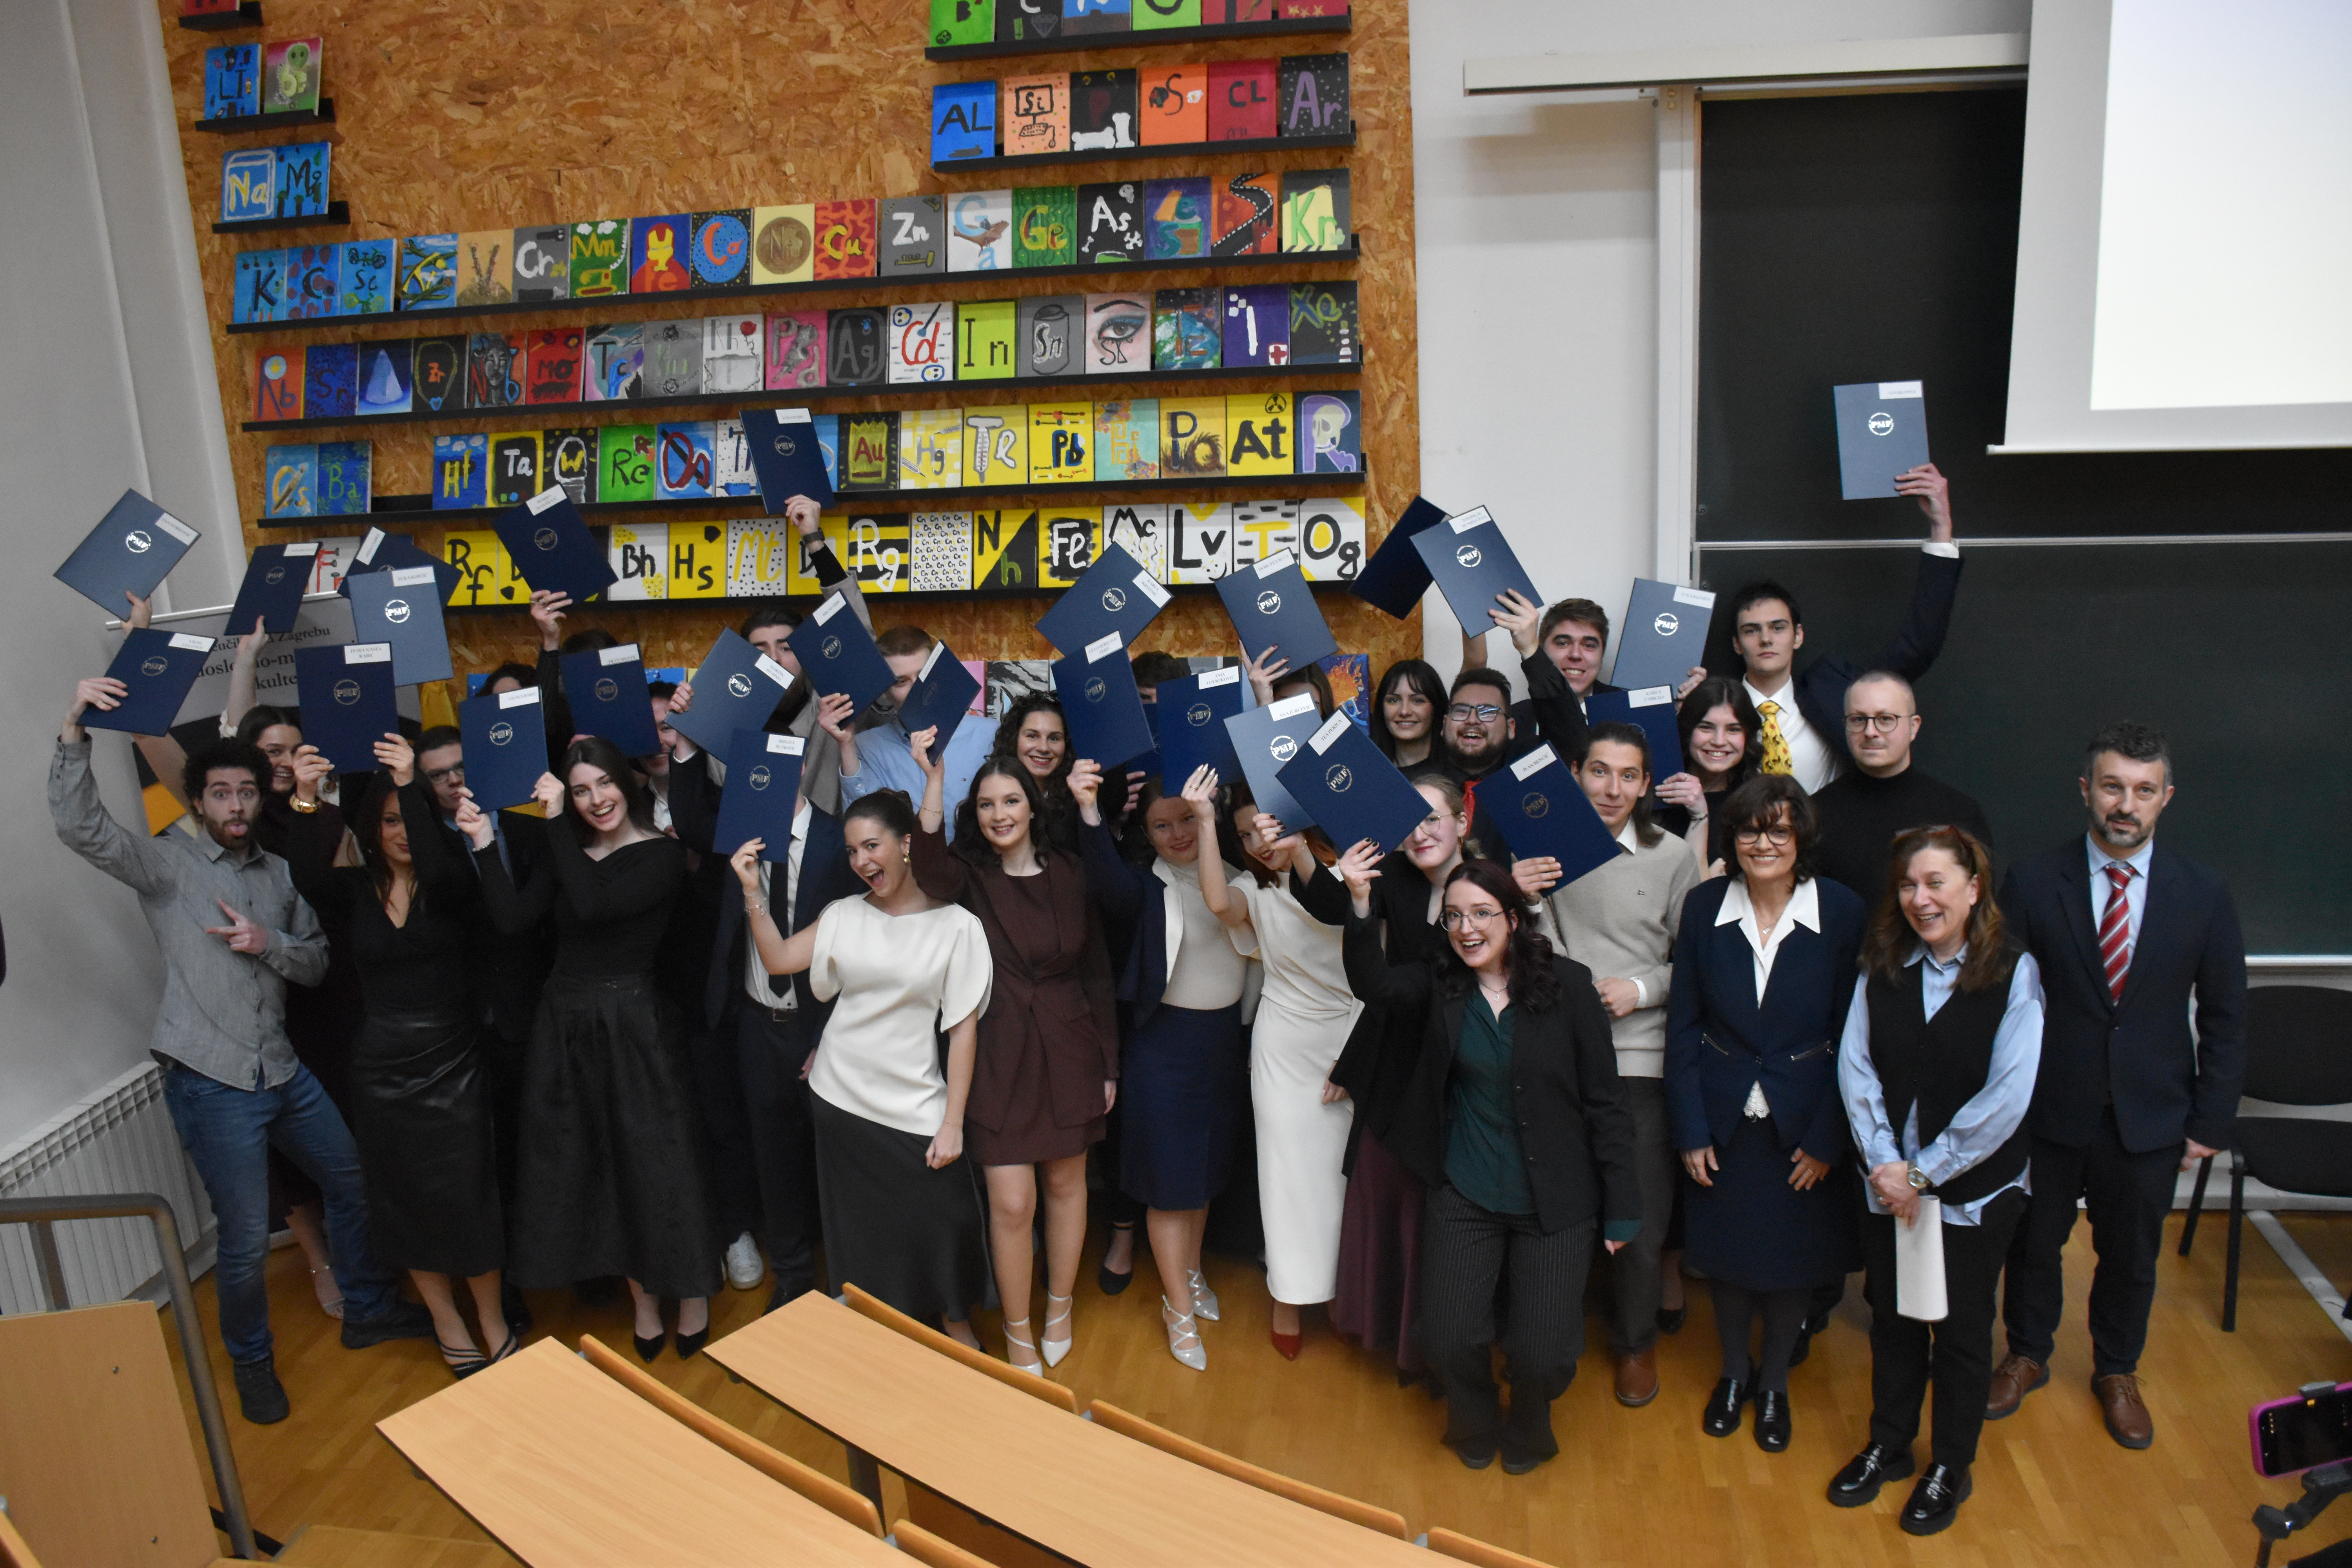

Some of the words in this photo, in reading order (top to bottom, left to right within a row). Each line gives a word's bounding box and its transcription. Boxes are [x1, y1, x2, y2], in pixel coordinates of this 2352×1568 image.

[1024, 92, 1044, 113] Si
[1165, 73, 1183, 116] S
[1289, 71, 1341, 129] Ar
[937, 102, 993, 135] AL
[229, 171, 267, 212] Na
[892, 212, 929, 245] Zn
[1022, 205, 1066, 251] Ge
[1091, 196, 1131, 232] As
[1290, 191, 1337, 247] Kr
[516, 241, 554, 278] Cr
[571, 233, 619, 259] Mn
[703, 223, 743, 265] Co
[824, 224, 863, 260] Cu
[254, 269, 278, 311] K
[711, 319, 738, 350] Rh
[902, 321, 940, 365] Cd
[964, 318, 1008, 367] In
[1033, 323, 1063, 363] Sn
[855, 436, 885, 464] Au
[916, 435, 945, 476] Hg
[1052, 430, 1085, 469] Pb
[1230, 417, 1287, 465] At
[504, 449, 533, 477] Ta
[561, 450, 584, 472] W
[612, 449, 650, 487] Re
[328, 464, 361, 499] Ba
[1109, 508, 1156, 542] Mc
[1173, 509, 1227, 568] Lv
[622, 544, 656, 579] Bh
[733, 529, 782, 583] Mt
[852, 519, 900, 592] Rg
[978, 510, 1022, 586] Nh
[1303, 514, 1361, 580] Og
[1460, 550, 1478, 563] PMF
[448, 539, 493, 605] Rf
[675, 543, 713, 591] Hs
[1147, 579, 1159, 591] KARLA
[387, 607, 409, 615] PMF
[1259, 596, 1278, 609] PMF
[278, 627, 330, 642] Zagrebu
[1657, 620, 1676, 628] PMF
[824, 639, 839, 655] PMF
[731, 679, 749, 693] PMF
[1321, 732, 1329, 741] TEA
[1327, 718, 1342, 734] PERICA
[1274, 742, 1294, 755] PMF
[1330, 769, 1349, 789] PMF
